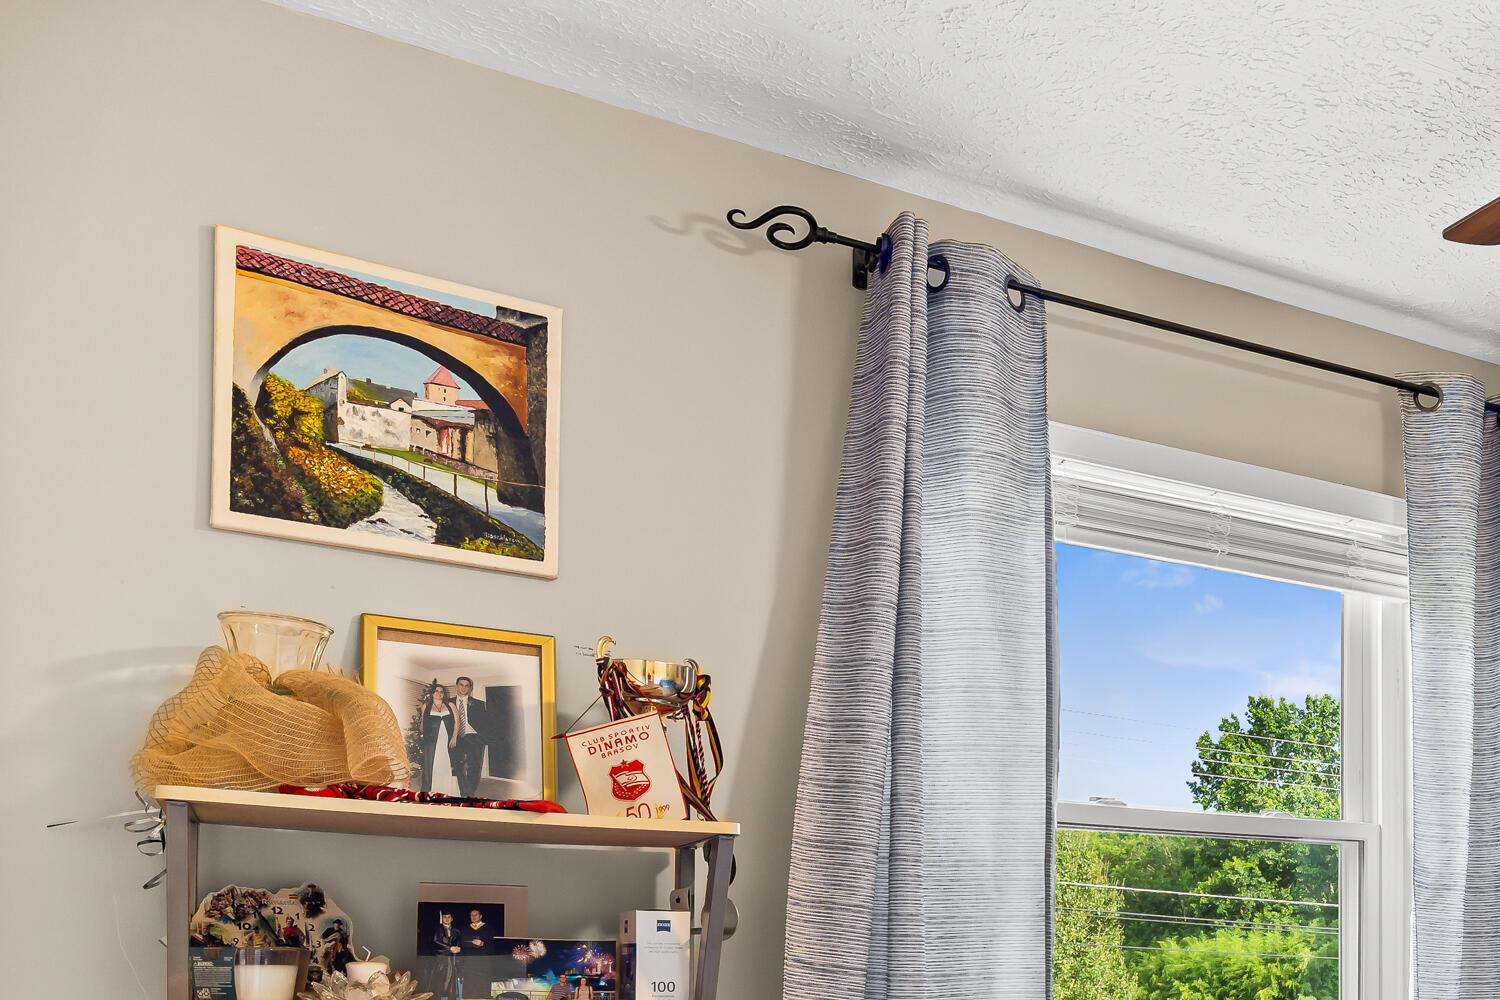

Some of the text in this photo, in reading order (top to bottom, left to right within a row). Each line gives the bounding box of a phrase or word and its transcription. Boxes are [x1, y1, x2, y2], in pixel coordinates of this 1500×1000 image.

[582, 724, 651, 747] CLUB SPORTIV
[587, 731, 650, 756] DINAMO
[601, 743, 639, 759] BRASOV
[271, 906, 284, 915] 12
[237, 922, 251, 930] 10
[308, 923, 315, 932] 2
[651, 981, 676, 993] 100
